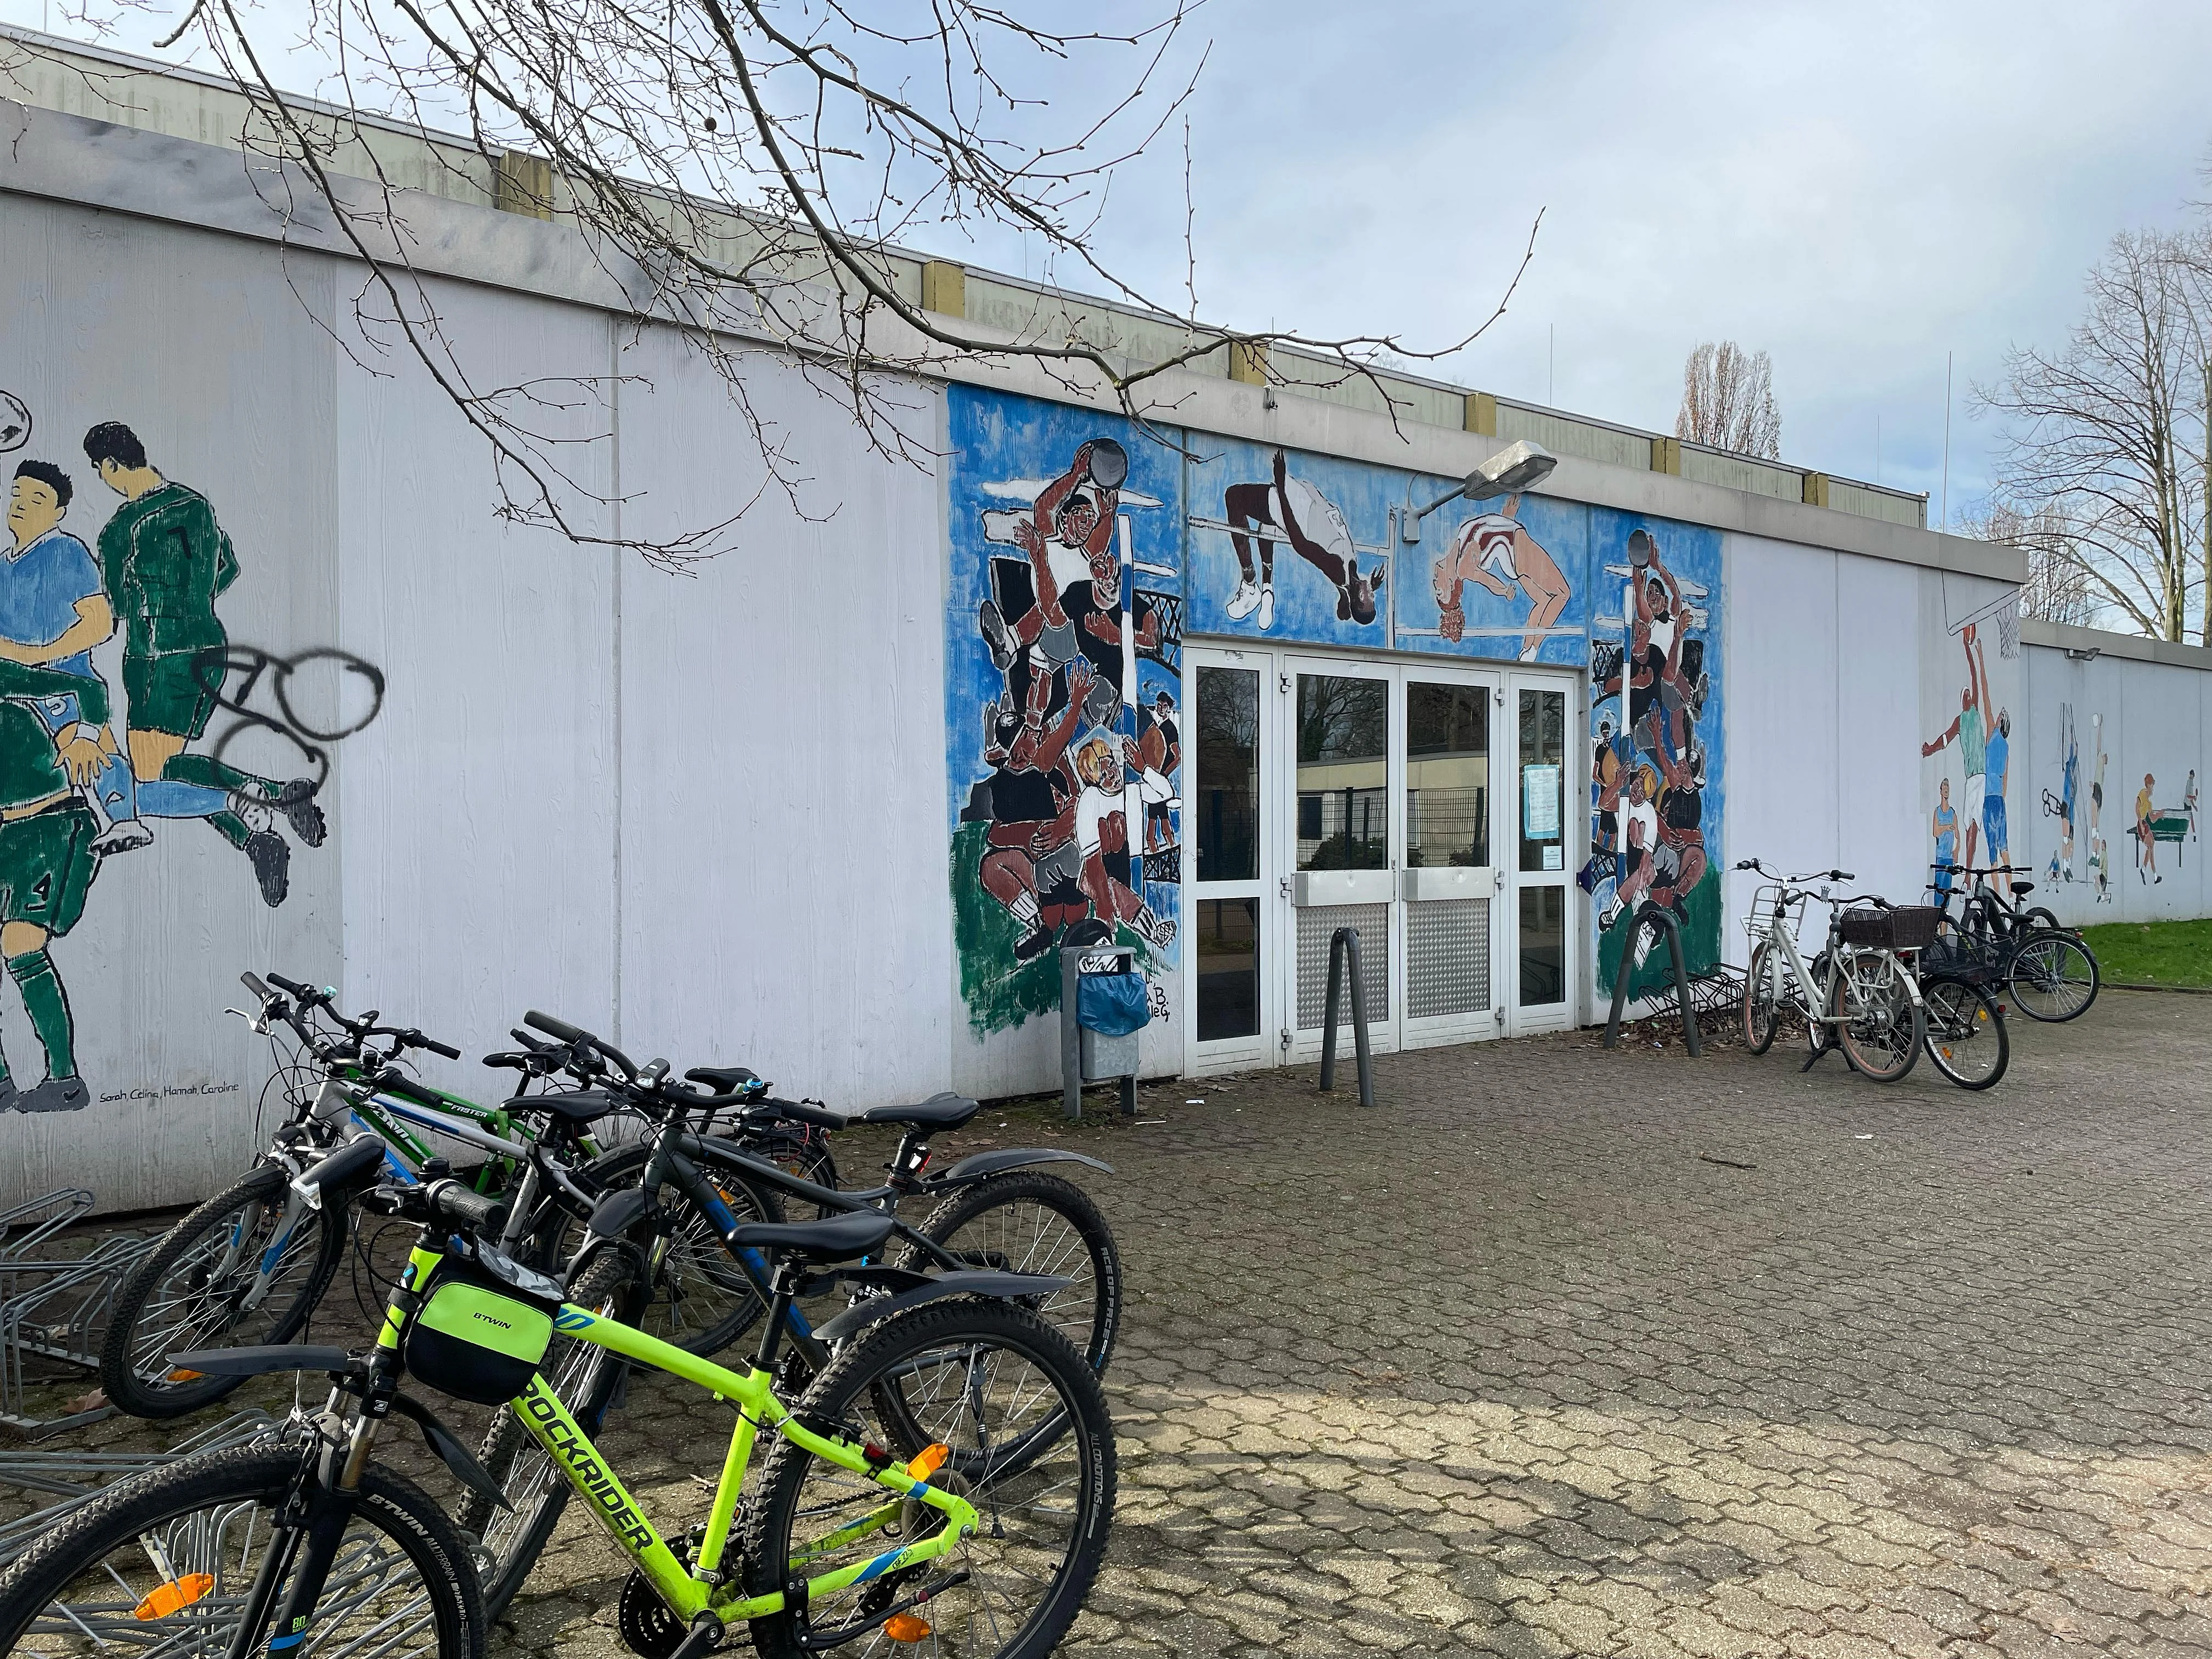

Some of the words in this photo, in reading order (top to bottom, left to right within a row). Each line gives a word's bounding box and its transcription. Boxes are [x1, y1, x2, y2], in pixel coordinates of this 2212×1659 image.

[99, 1090, 128, 1103] Sarah,
[163, 1085, 199, 1098] Hannah,
[201, 1081, 239, 1094] Caroline
[450, 1105, 488, 1117] FASTER
[473, 1312, 512, 1329] B'TWIN
